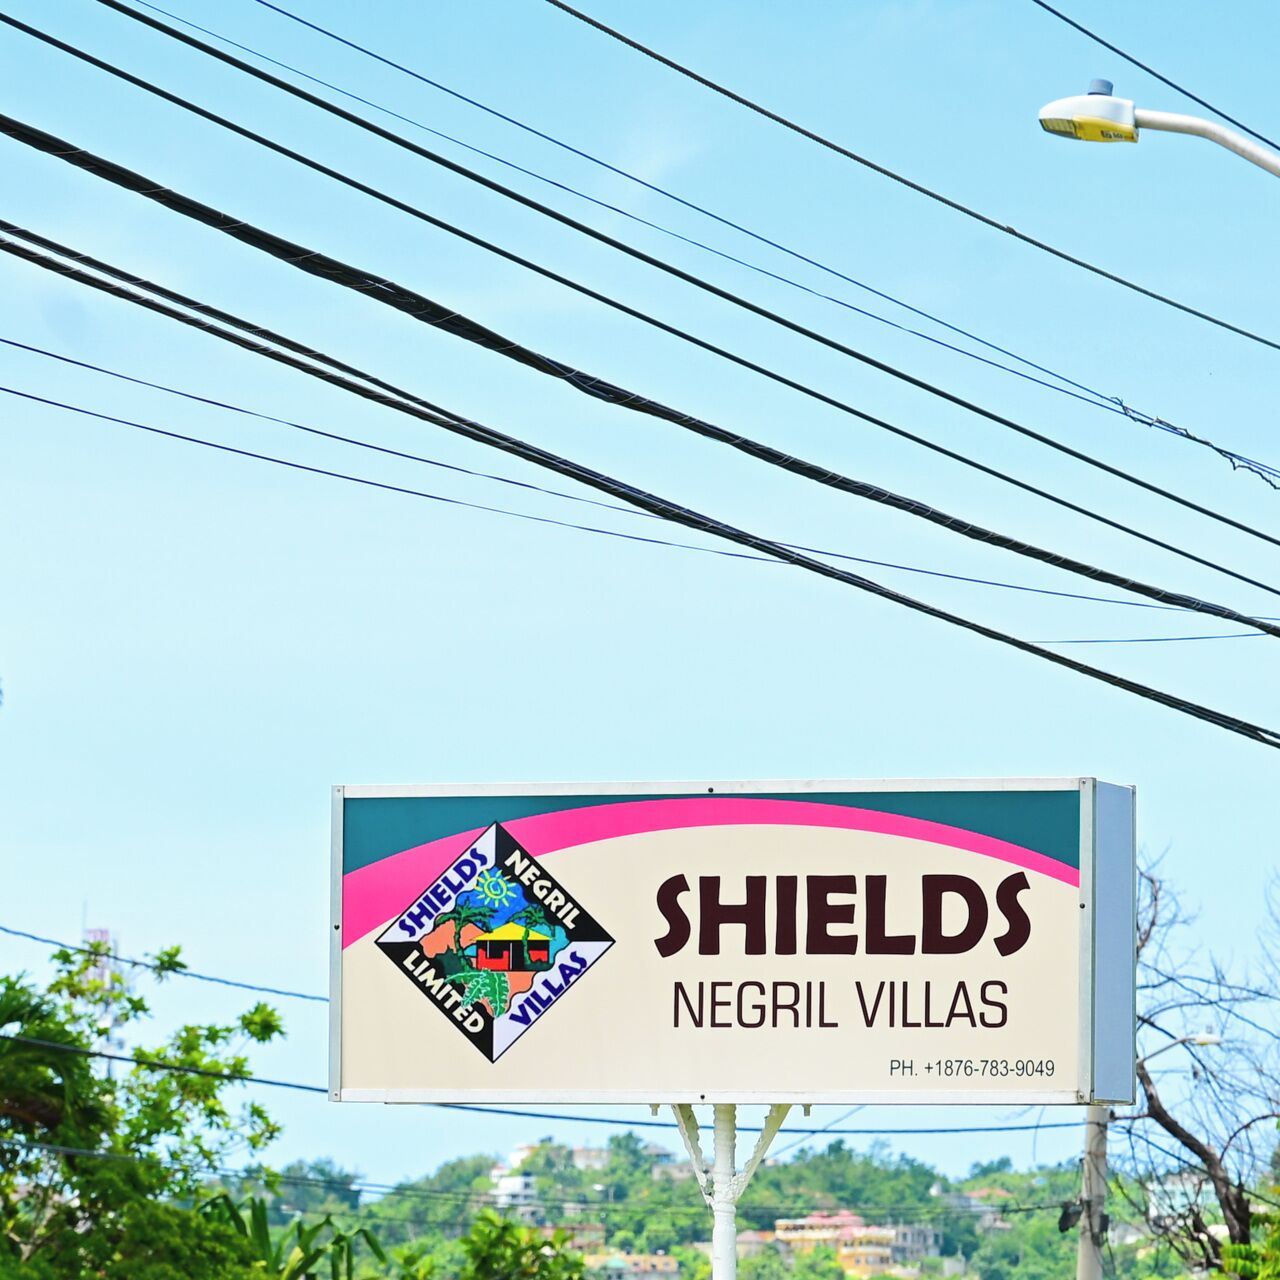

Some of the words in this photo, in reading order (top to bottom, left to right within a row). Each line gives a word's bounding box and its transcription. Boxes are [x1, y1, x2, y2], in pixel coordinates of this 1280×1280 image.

[398, 847, 488, 938] SHIELDS
[504, 849, 581, 930] NEGRIL
[653, 871, 1032, 958] SHIELDS
[402, 949, 485, 1033] LIMITED
[508, 951, 588, 1026] VILLAS
[673, 980, 839, 1029] NEGRIL
[854, 980, 1008, 1029] VILLAS
[889, 1059, 918, 1077] PH.
[924, 1059, 1055, 1077] +1876-783-9049
